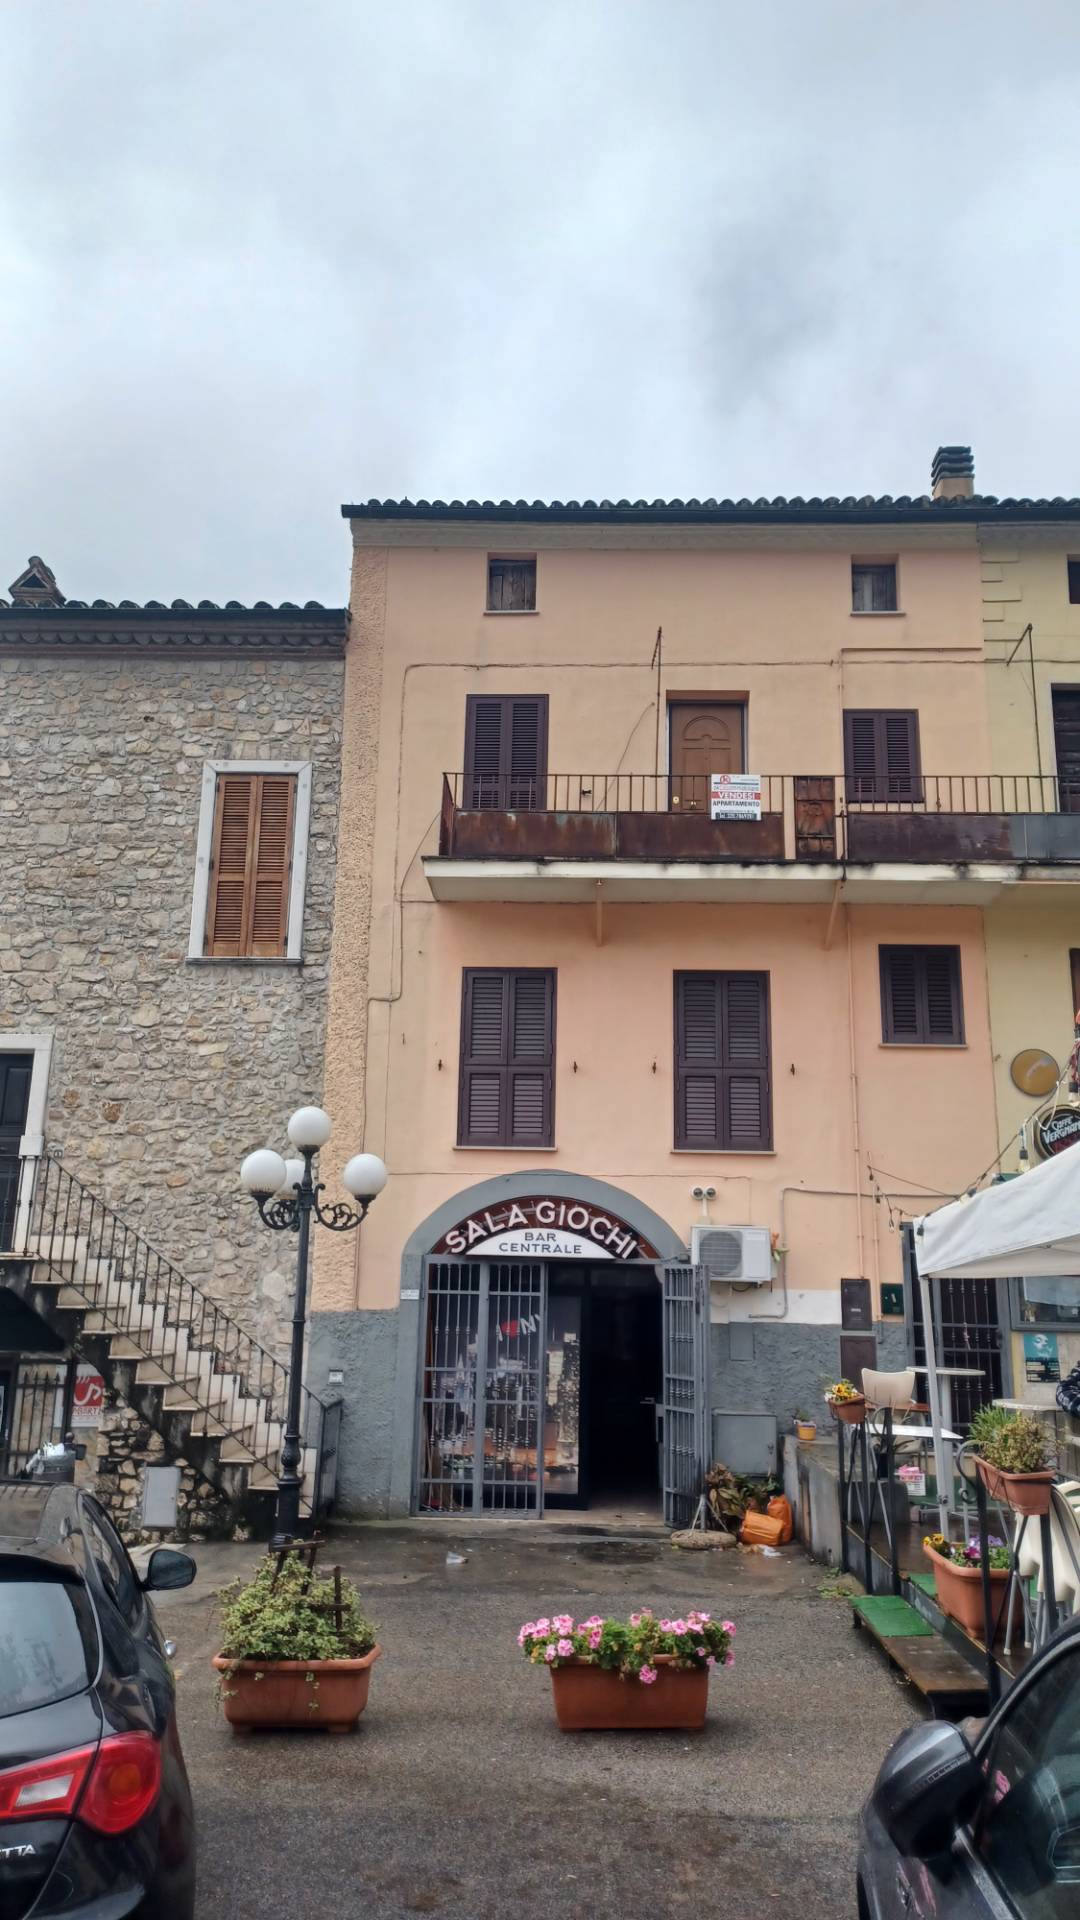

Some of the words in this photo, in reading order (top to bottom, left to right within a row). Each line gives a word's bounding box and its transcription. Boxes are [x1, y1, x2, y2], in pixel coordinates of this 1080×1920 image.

[719, 792, 755, 800] VENDESI
[1042, 1120, 1080, 1144] VERGNAN
[445, 1204, 528, 1253] SALA
[535, 1201, 638, 1259] GIOCHI
[524, 1232, 557, 1242] BAR
[499, 1243, 582, 1254] CENTRALE
[0, 1844, 36, 1858] TTA
